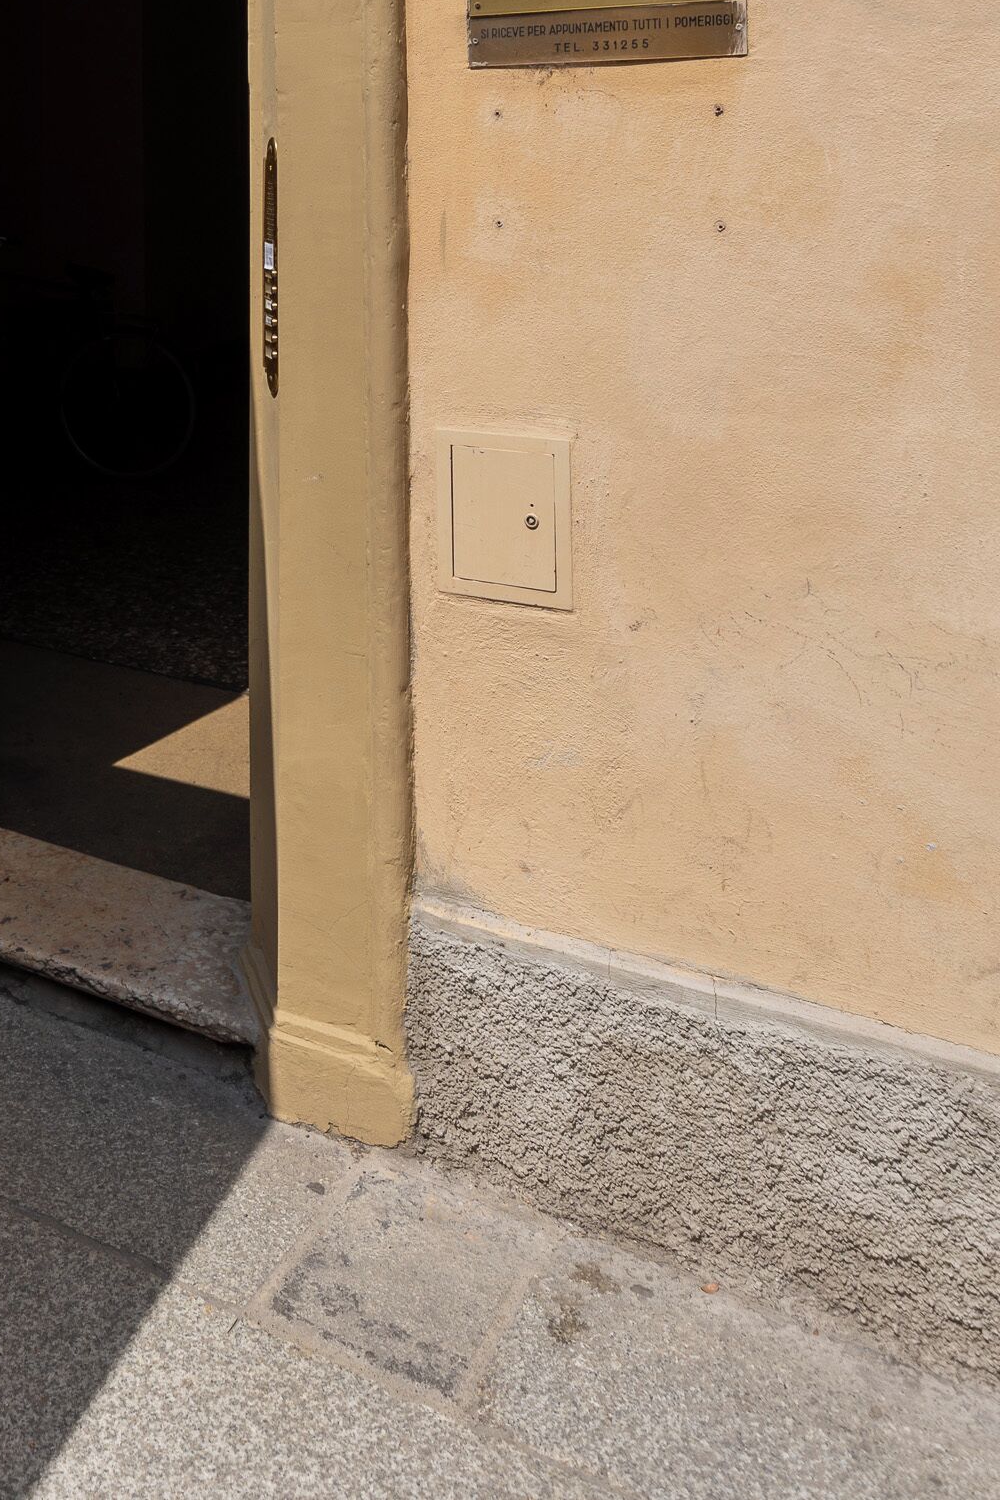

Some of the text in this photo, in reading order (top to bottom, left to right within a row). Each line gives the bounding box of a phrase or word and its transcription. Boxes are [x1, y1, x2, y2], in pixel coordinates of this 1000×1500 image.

[480, 13, 735, 40] SI RICEVE PER APPUNTAMENTO TUTTI I POMERIGGI
[554, 39, 649, 53] TEL. 331255
